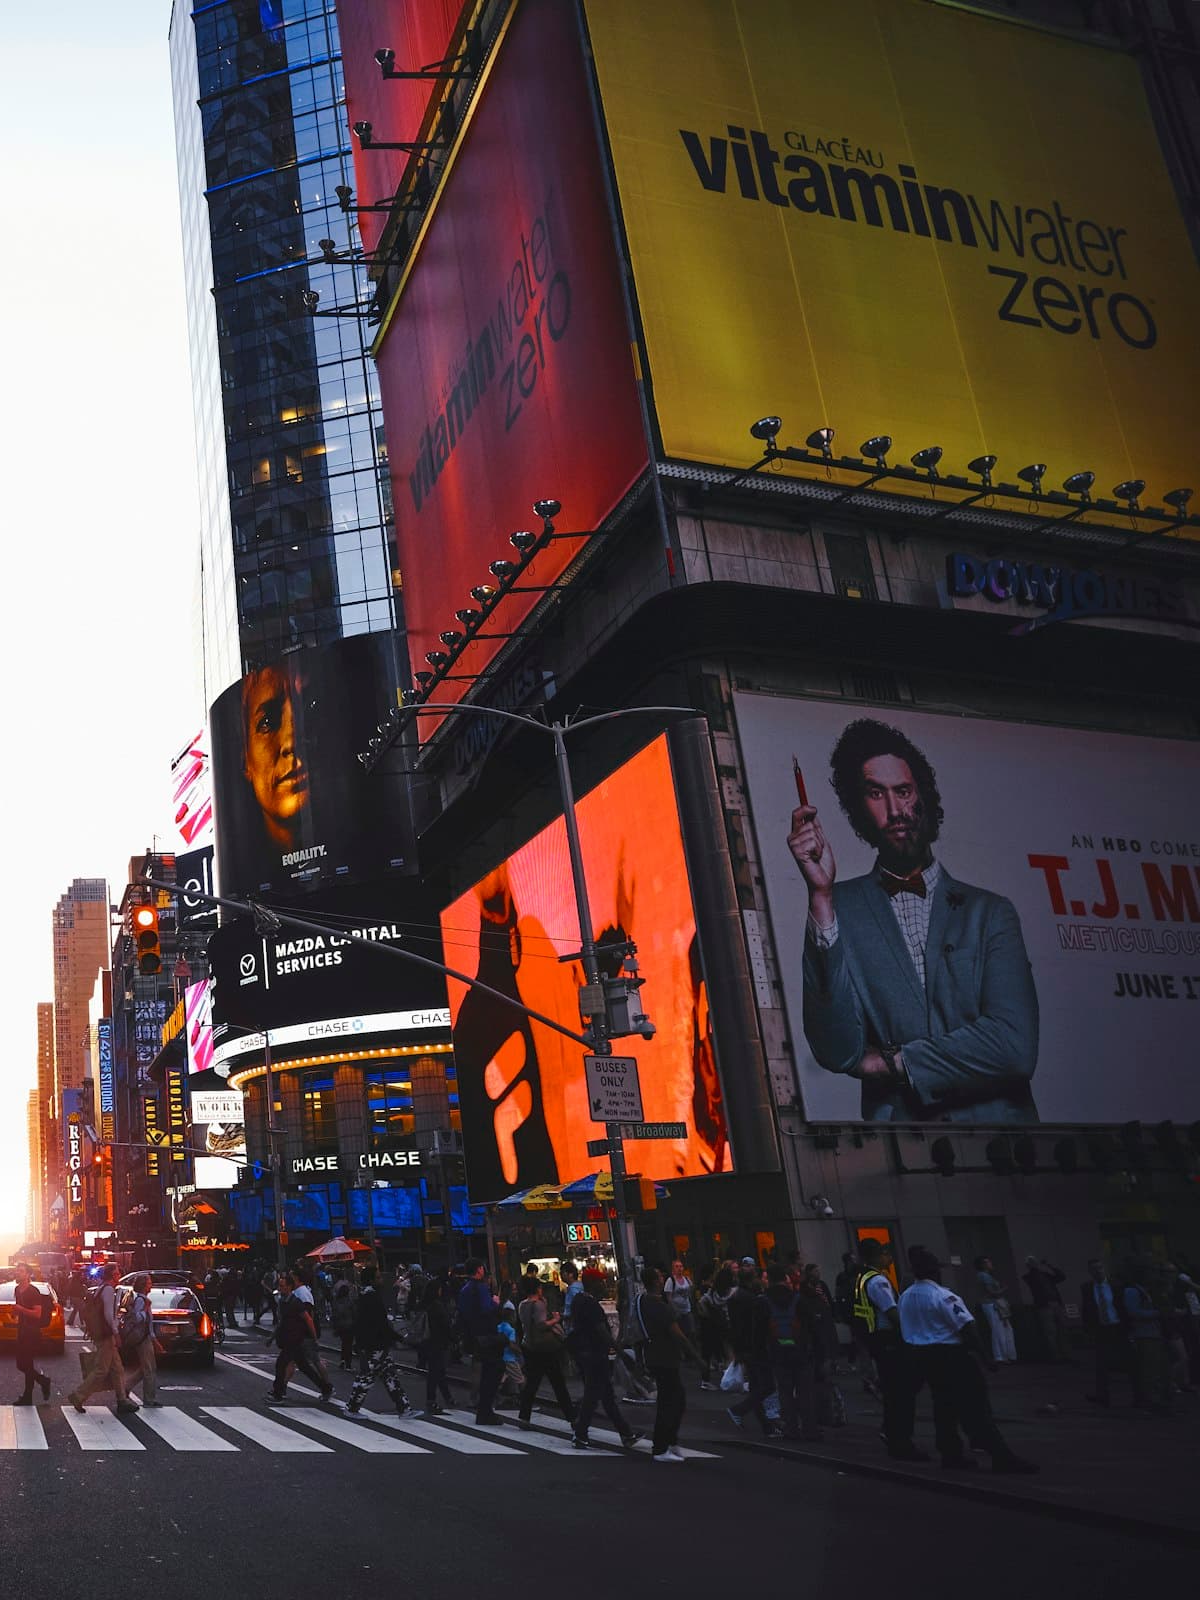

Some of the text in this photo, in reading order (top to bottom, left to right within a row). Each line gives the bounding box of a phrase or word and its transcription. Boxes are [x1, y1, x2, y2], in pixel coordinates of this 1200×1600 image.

[679, 125, 1129, 281] vitaminwater
[987, 264, 1158, 350] zero
[410, 192, 563, 512] vitaminwater
[499, 271, 571, 432] zero
[948, 553, 1183, 618] DOW JONES
[281, 844, 328, 867] EQUALITY.
[1071, 834, 1094, 849] AN
[1102, 836, 1141, 854] HBO
[275, 935, 325, 958] MAZDA
[276, 950, 342, 976] SERVICES
[1114, 972, 1179, 1000] JUNE
[308, 1021, 350, 1036] CHASE
[240, 1037, 265, 1050] CHASE
[595, 1061, 627, 1074] BUSES
[101, 1073, 113, 1113] STUDIOS
[601, 1076, 624, 1087] ONLY
[168, 1070, 183, 1127] VICTORY
[199, 1102, 241, 1111] WORK
[605, 1108, 618, 1116] MON
[145, 1098, 159, 1176] TORY NEW
[636, 1124, 684, 1138] Broadway
[68, 1124, 81, 1202] REGAL
[292, 1155, 339, 1174] CHASE
[359, 1150, 421, 1169] CHASE
[165, 1184, 196, 1196] SKCHERS
[569, 1224, 600, 1241] SODA
